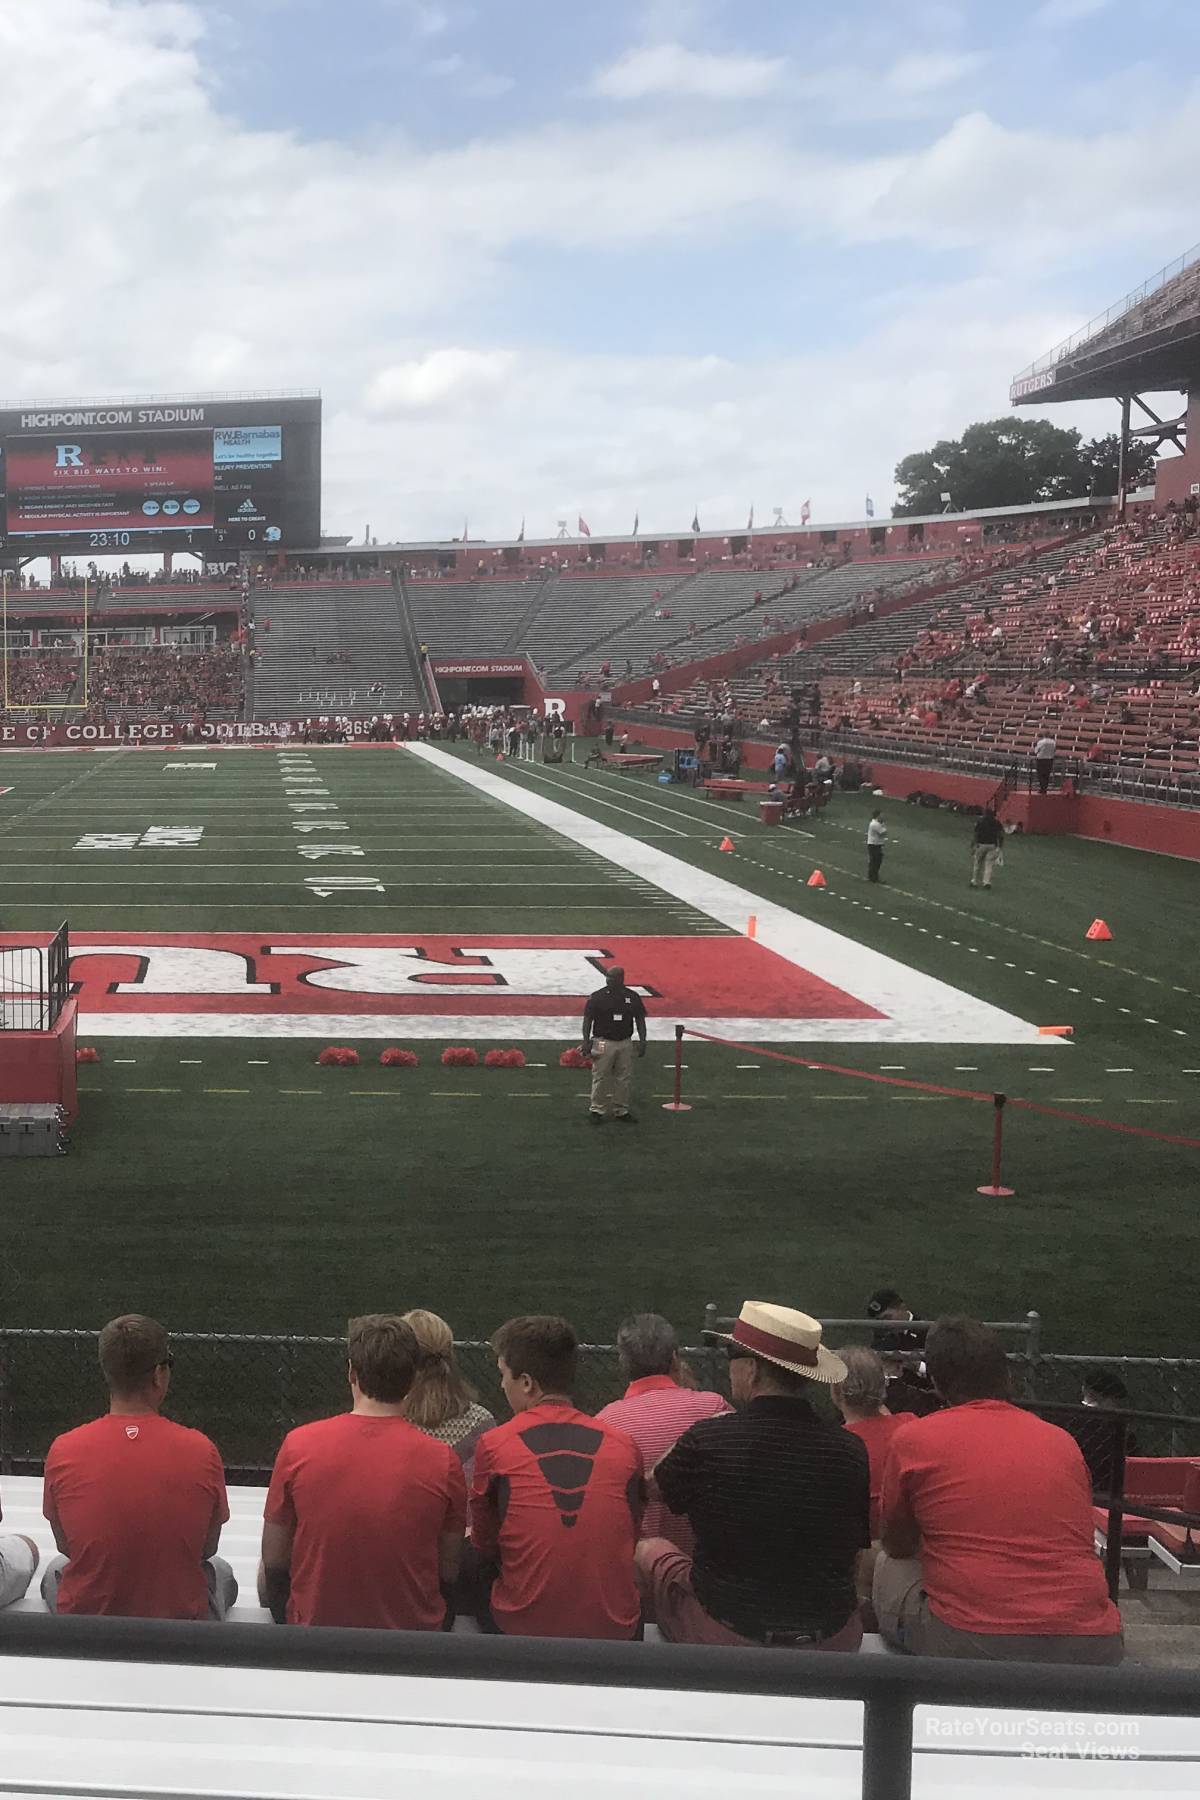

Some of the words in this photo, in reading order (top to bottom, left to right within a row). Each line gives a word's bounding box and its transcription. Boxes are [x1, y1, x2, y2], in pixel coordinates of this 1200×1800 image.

[1010, 371, 1053, 399] RUTGERS
[21, 411, 132, 428] HIGHPOINT.COM
[138, 408, 204, 423] STADIUM
[55, 445, 83, 466] R
[90, 532, 129, 547] 23:10
[187, 534, 193, 543] 1
[248, 529, 256, 541] 0
[435, 665, 489, 673] HIGHPOINT.COM
[491, 664, 522, 672] STADIUM
[544, 698, 567, 722] R
[66, 724, 174, 739] COLLEGE
